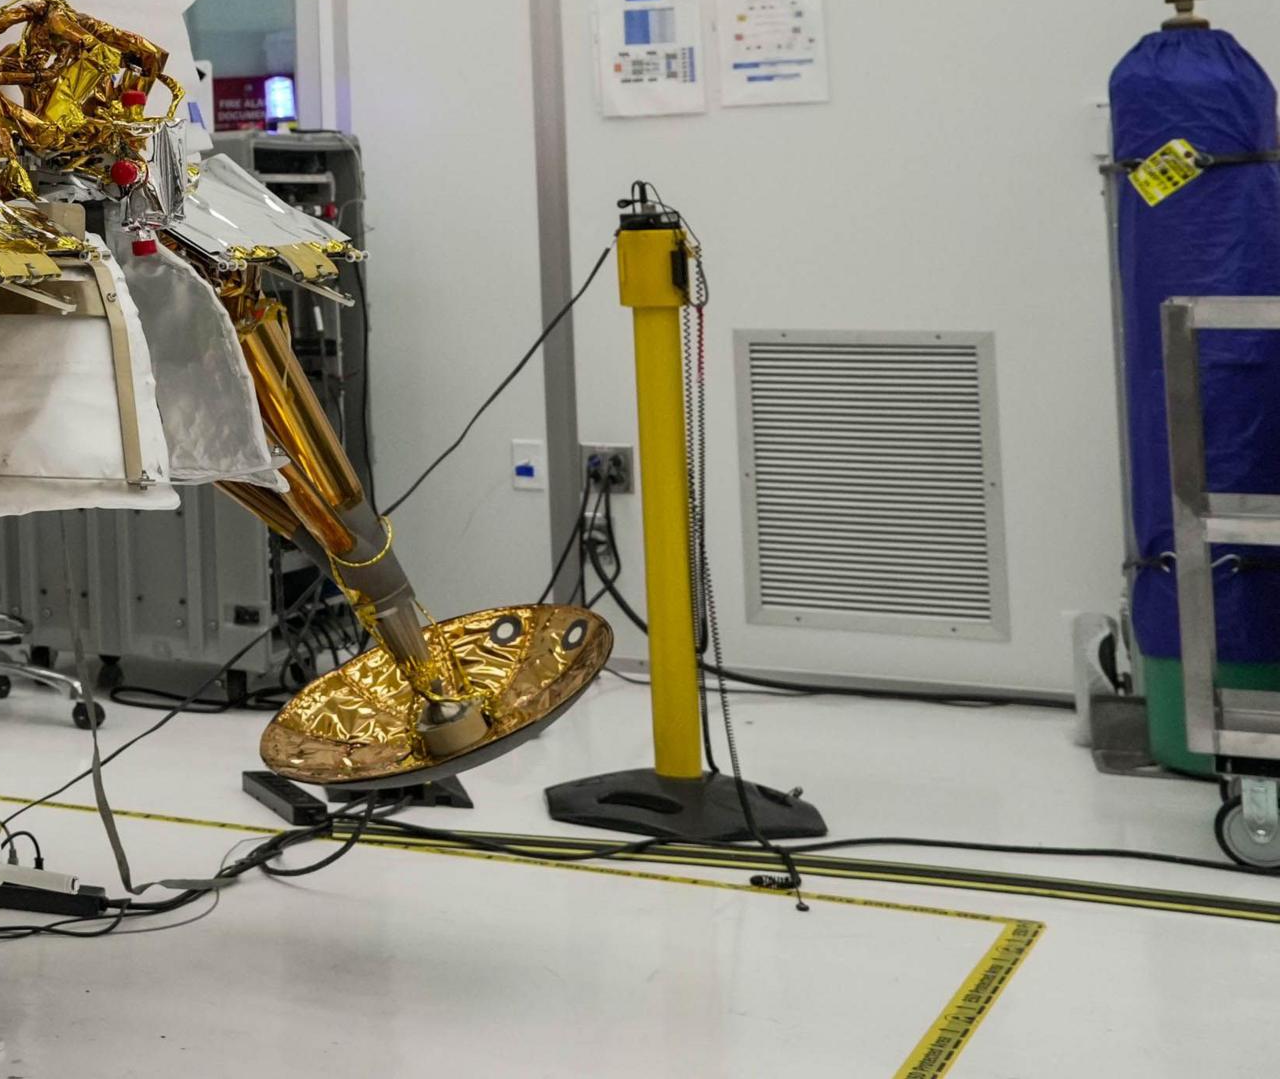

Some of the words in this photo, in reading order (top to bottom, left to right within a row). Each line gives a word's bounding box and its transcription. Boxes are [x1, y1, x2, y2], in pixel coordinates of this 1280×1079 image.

[219, 100, 241, 108] FIRE
[244, 98, 264, 108] ALA
[218, 111, 265, 121] DOCUME
